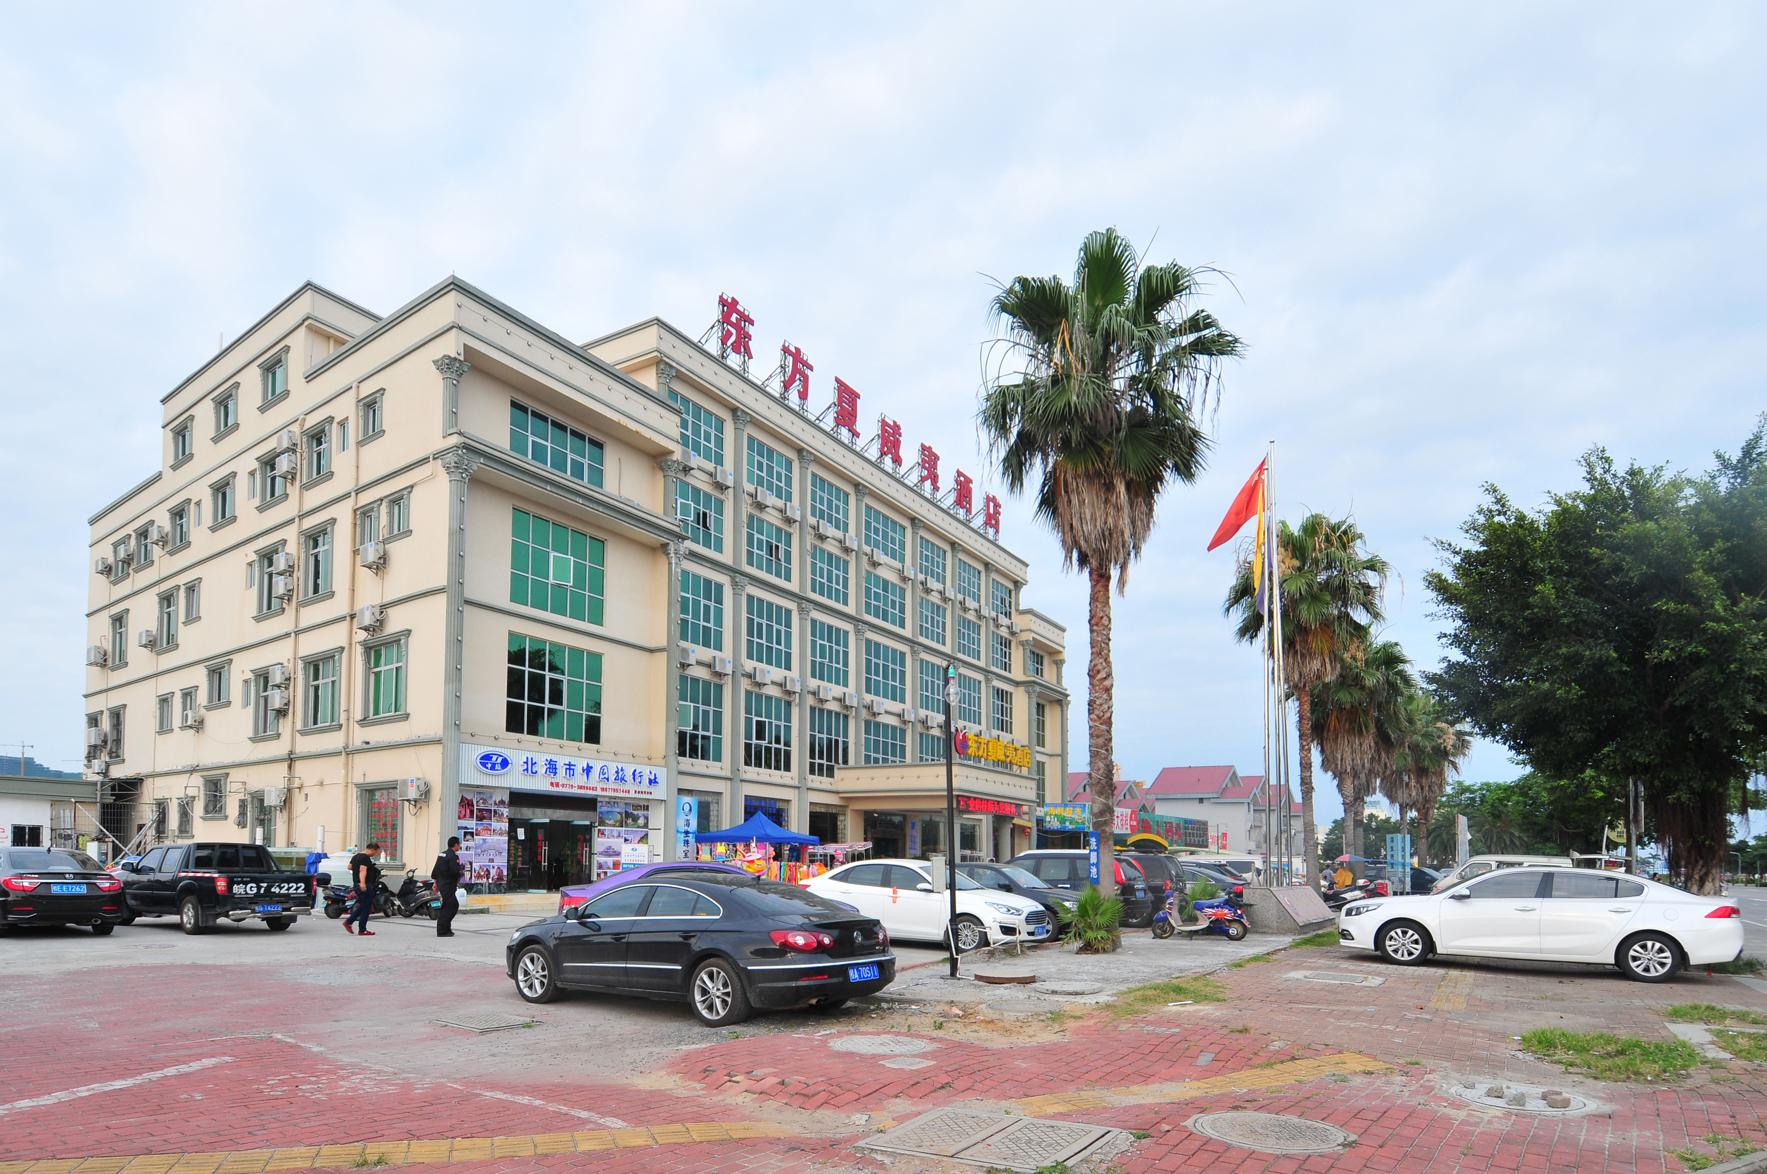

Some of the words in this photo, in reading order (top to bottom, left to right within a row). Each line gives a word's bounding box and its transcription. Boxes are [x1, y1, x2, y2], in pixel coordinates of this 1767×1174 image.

[718, 294, 1002, 534] 东方夏威夷酒店
[967, 733, 1032, 768] 东方夏威夷酒店
[522, 756, 660, 787] 北海市中国旅行社
